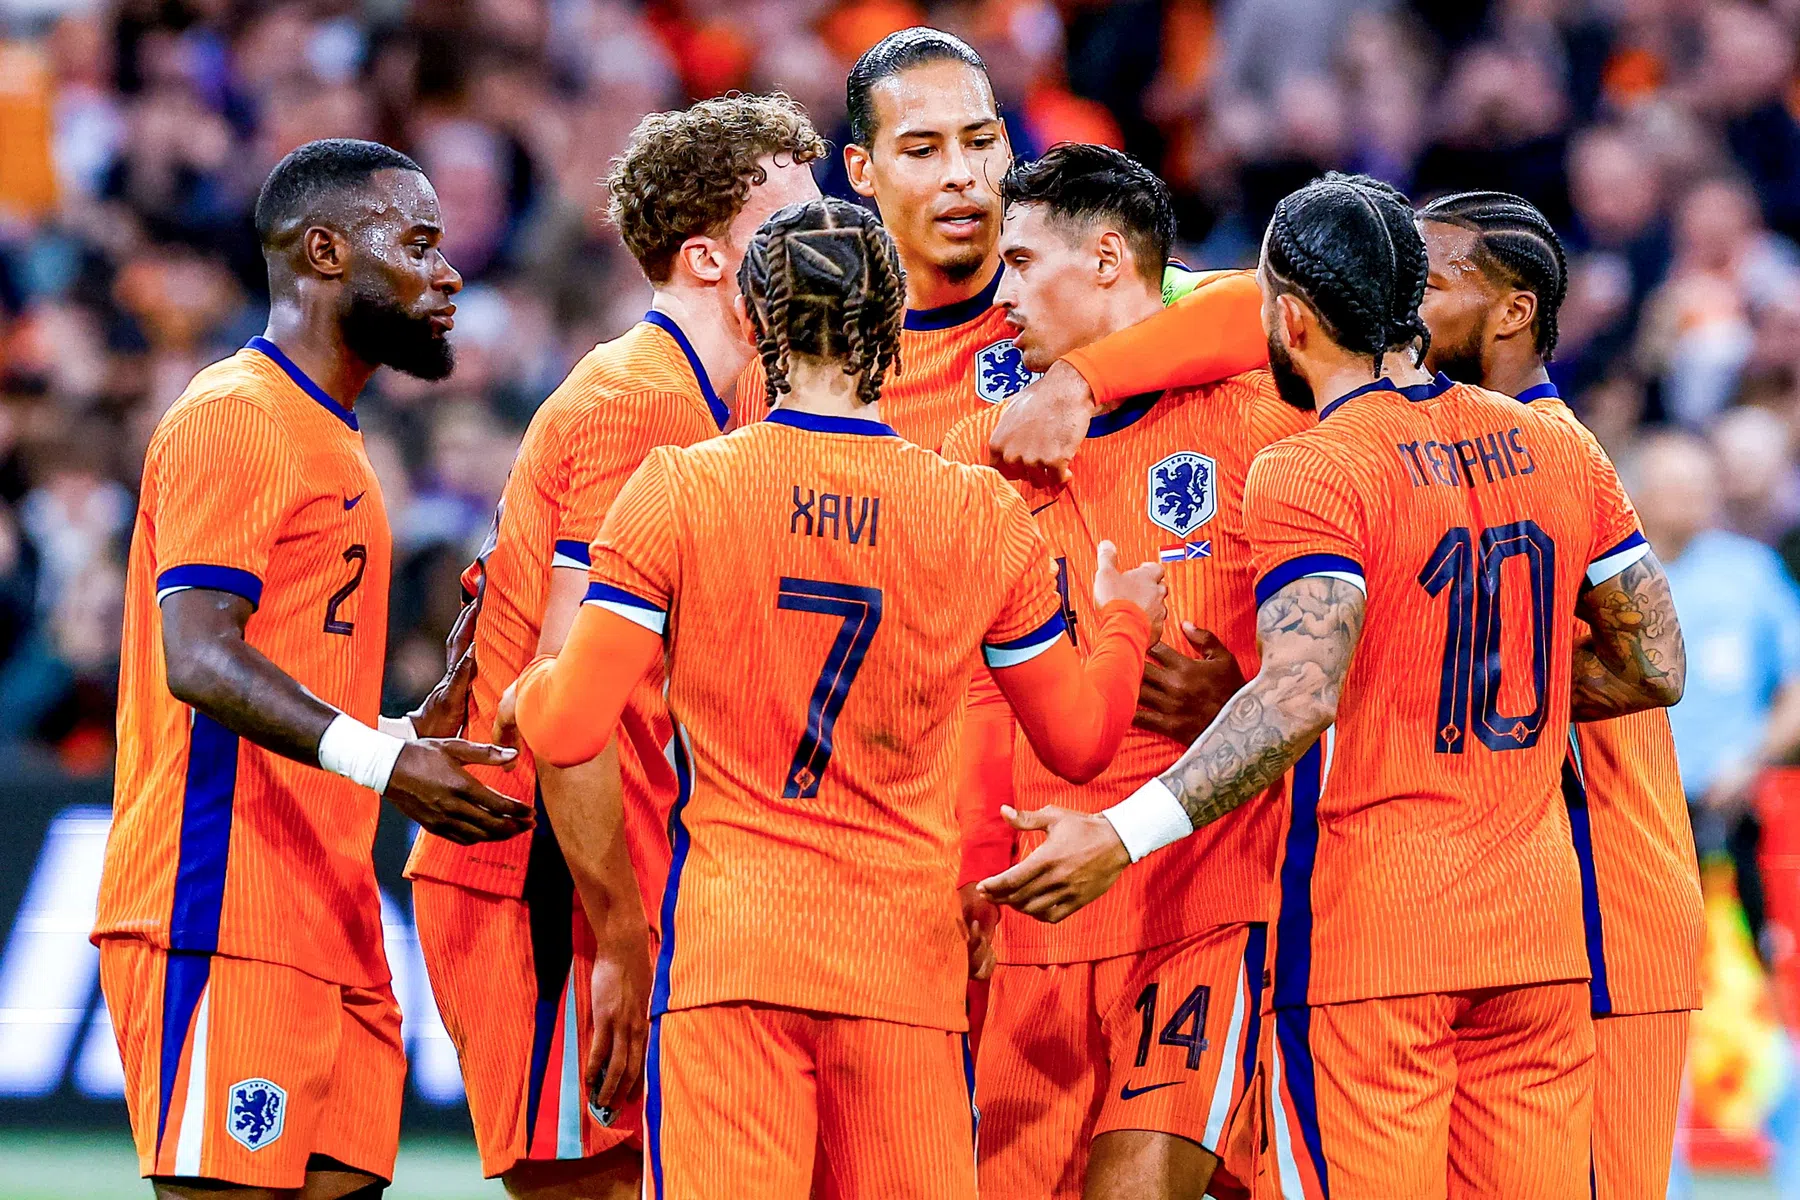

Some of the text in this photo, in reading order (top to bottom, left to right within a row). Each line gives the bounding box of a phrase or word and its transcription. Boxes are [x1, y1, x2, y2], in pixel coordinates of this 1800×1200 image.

[790, 485, 880, 547] XAVI
[323, 543, 367, 637] 2
[1417, 519, 1556, 754] 10
[777, 576, 883, 799] 7
[1134, 982, 1211, 1071] 14
